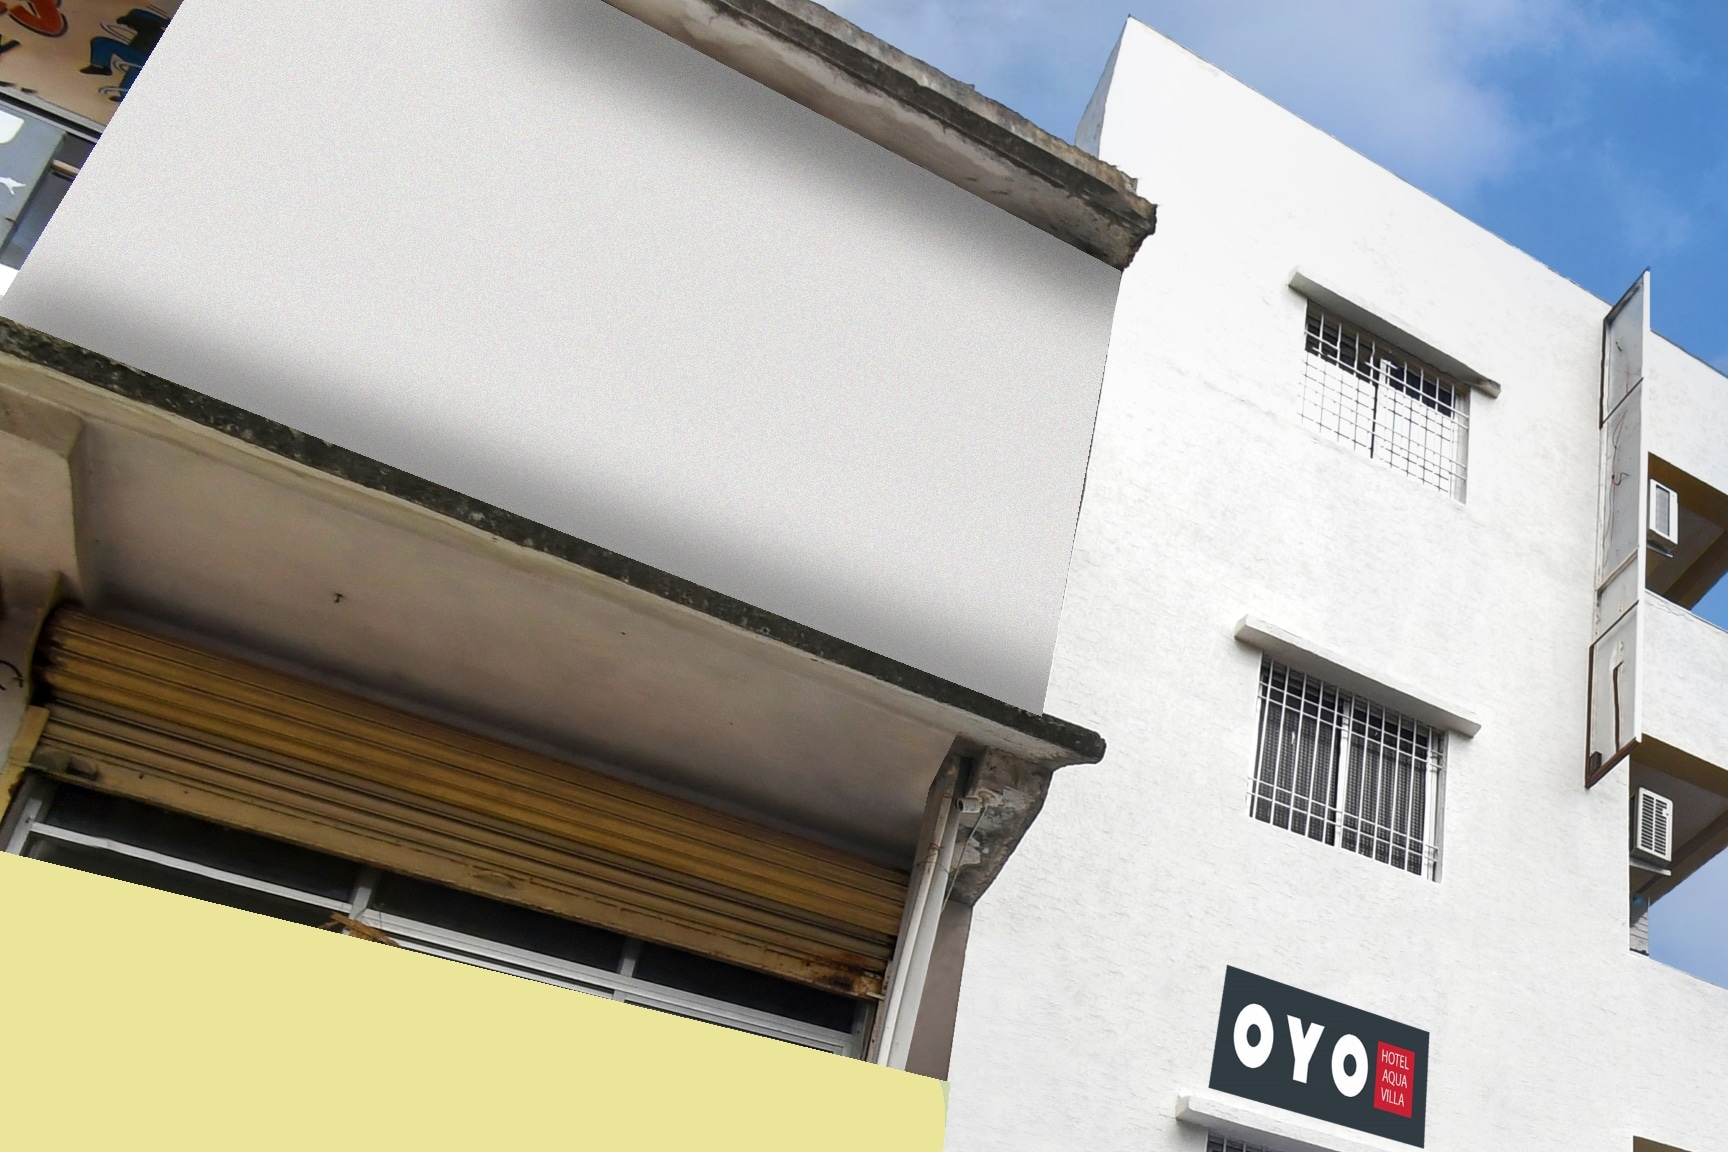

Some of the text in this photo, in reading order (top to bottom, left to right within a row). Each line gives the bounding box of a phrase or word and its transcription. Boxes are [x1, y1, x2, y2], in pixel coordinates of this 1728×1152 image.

[1233, 1003, 1369, 1097] OYO
[1381, 1049, 1409, 1070] HOTEL
[1381, 1069, 1408, 1089] AQUA
[1380, 1087, 1405, 1107] VILLA
